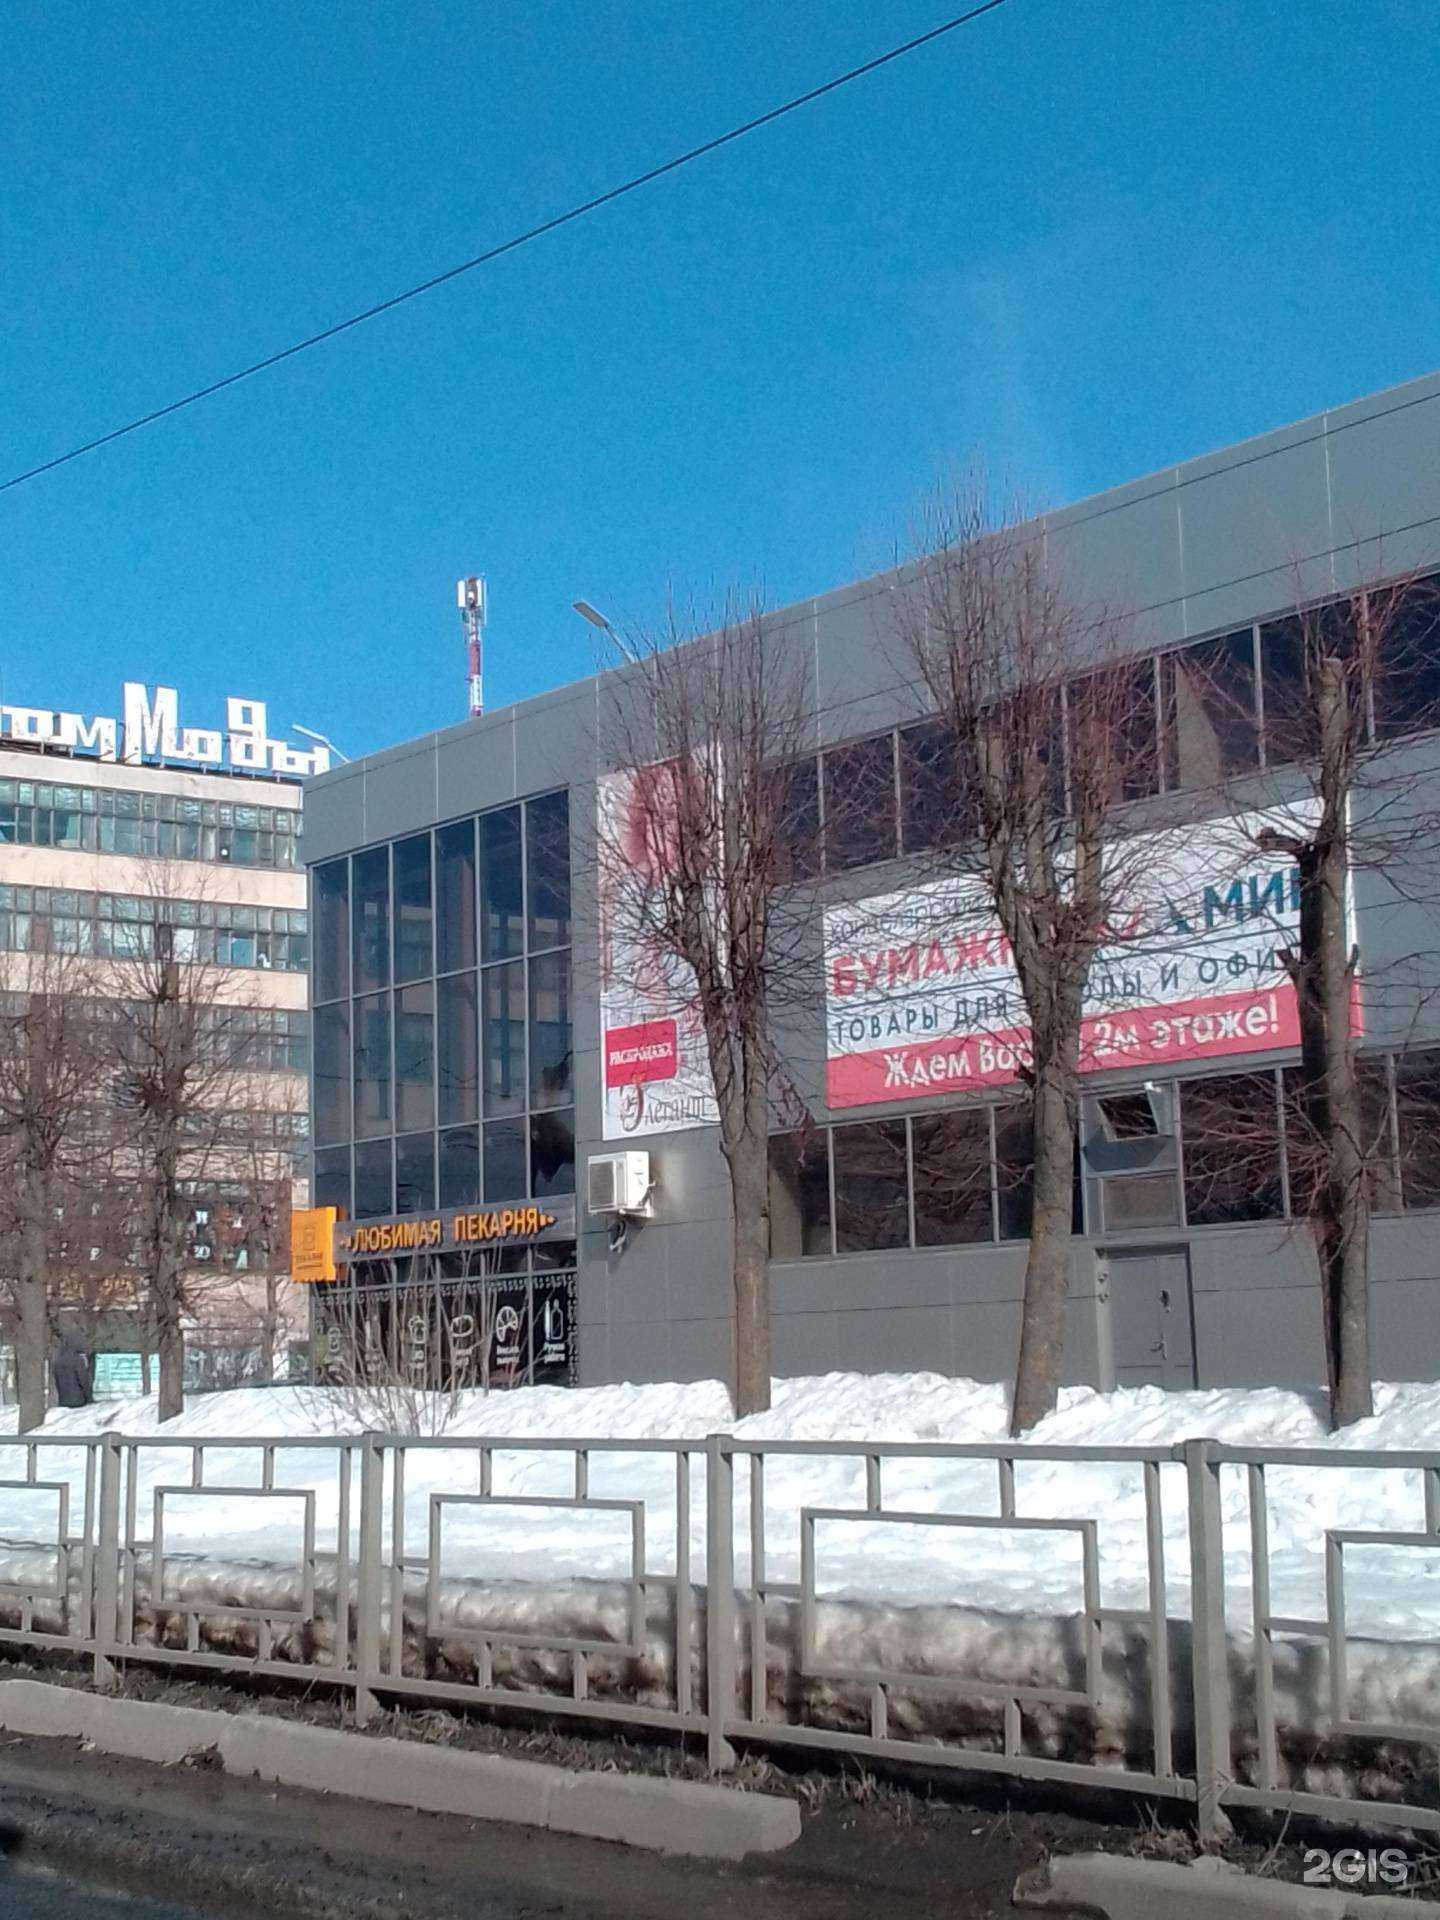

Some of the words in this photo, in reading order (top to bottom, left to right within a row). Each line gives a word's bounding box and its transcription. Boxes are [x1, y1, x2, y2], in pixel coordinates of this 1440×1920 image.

[836, 1008, 938, 1044] ТОВАРЫ
[954, 994, 1008, 1029] ДЛЯ
[1160, 962, 1179, 990] И
[1198, 949, 1276, 984] ОФИ
[884, 1052, 972, 1088] Ждем
[980, 1040, 1034, 1073] Вас
[1092, 1022, 1141, 1055] 2м
[1150, 995, 1280, 1047] этаже!
[351, 1219, 442, 1252] ЛЮБИМАЯ
[454, 1208, 539, 1241] ПЕКАРНЯ
